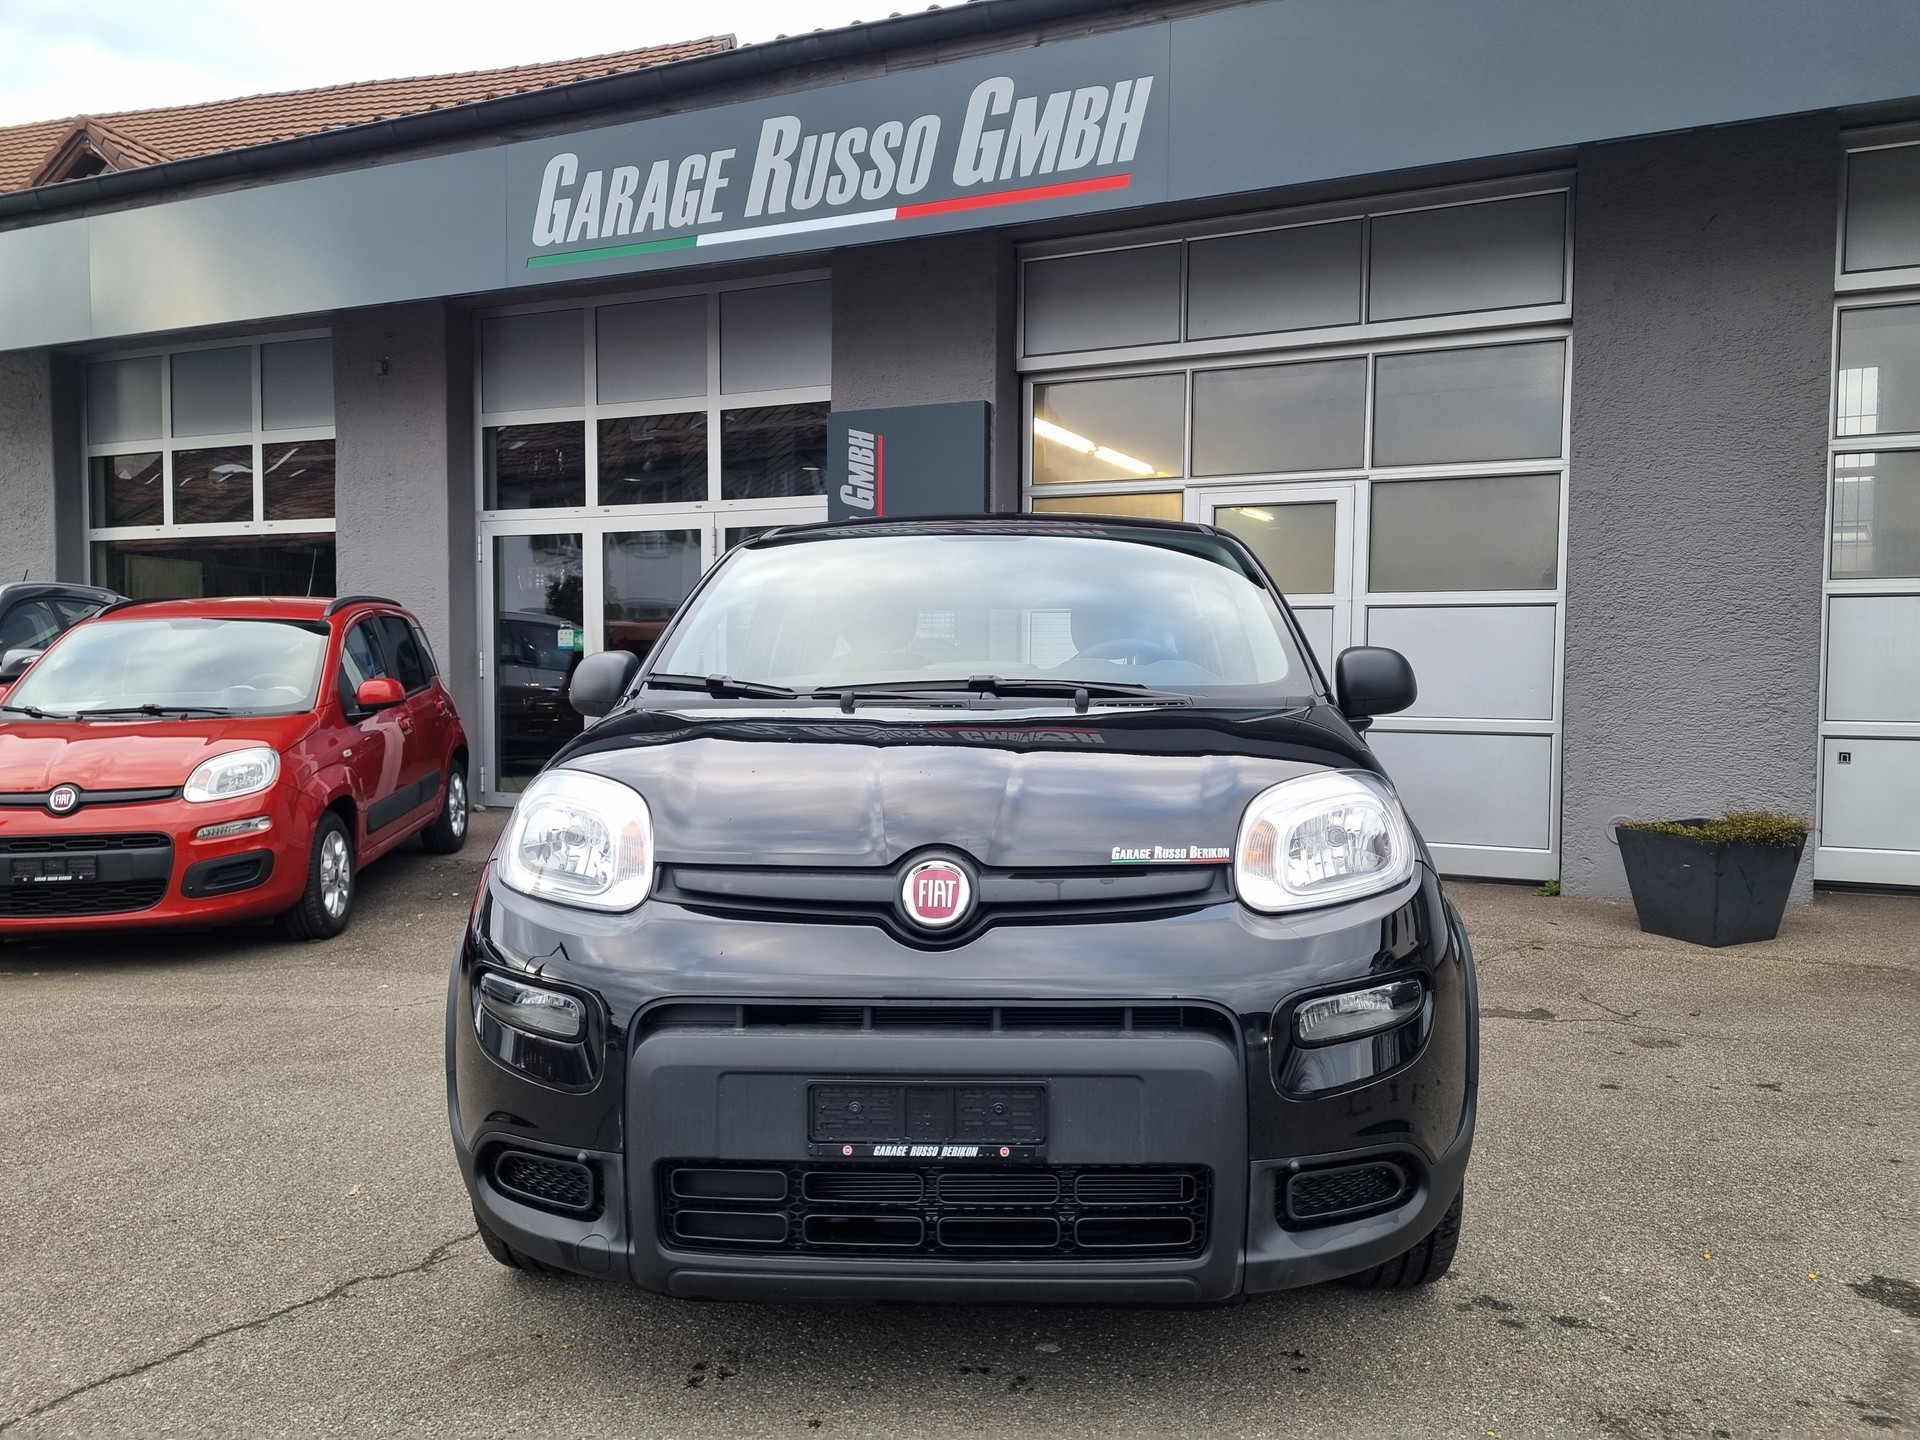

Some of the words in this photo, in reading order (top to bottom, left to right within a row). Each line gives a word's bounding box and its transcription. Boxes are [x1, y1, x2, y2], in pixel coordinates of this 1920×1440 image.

[532, 149, 737, 246] GARAGE
[744, 114, 942, 218] RUSSO
[953, 76, 1154, 187] GMBH
[840, 429, 875, 510] GMBH
[55, 793, 70, 806] FIAT
[1111, 846, 1152, 860] GARAGE
[1153, 845, 1187, 859] RUSSO
[1189, 845, 1230, 859] BERIKON
[918, 879, 956, 908] FIAT
[873, 1145, 908, 1156] GARAGE
[909, 1146, 940, 1157] RUSSO
[940, 1146, 979, 1157] BERIKON
